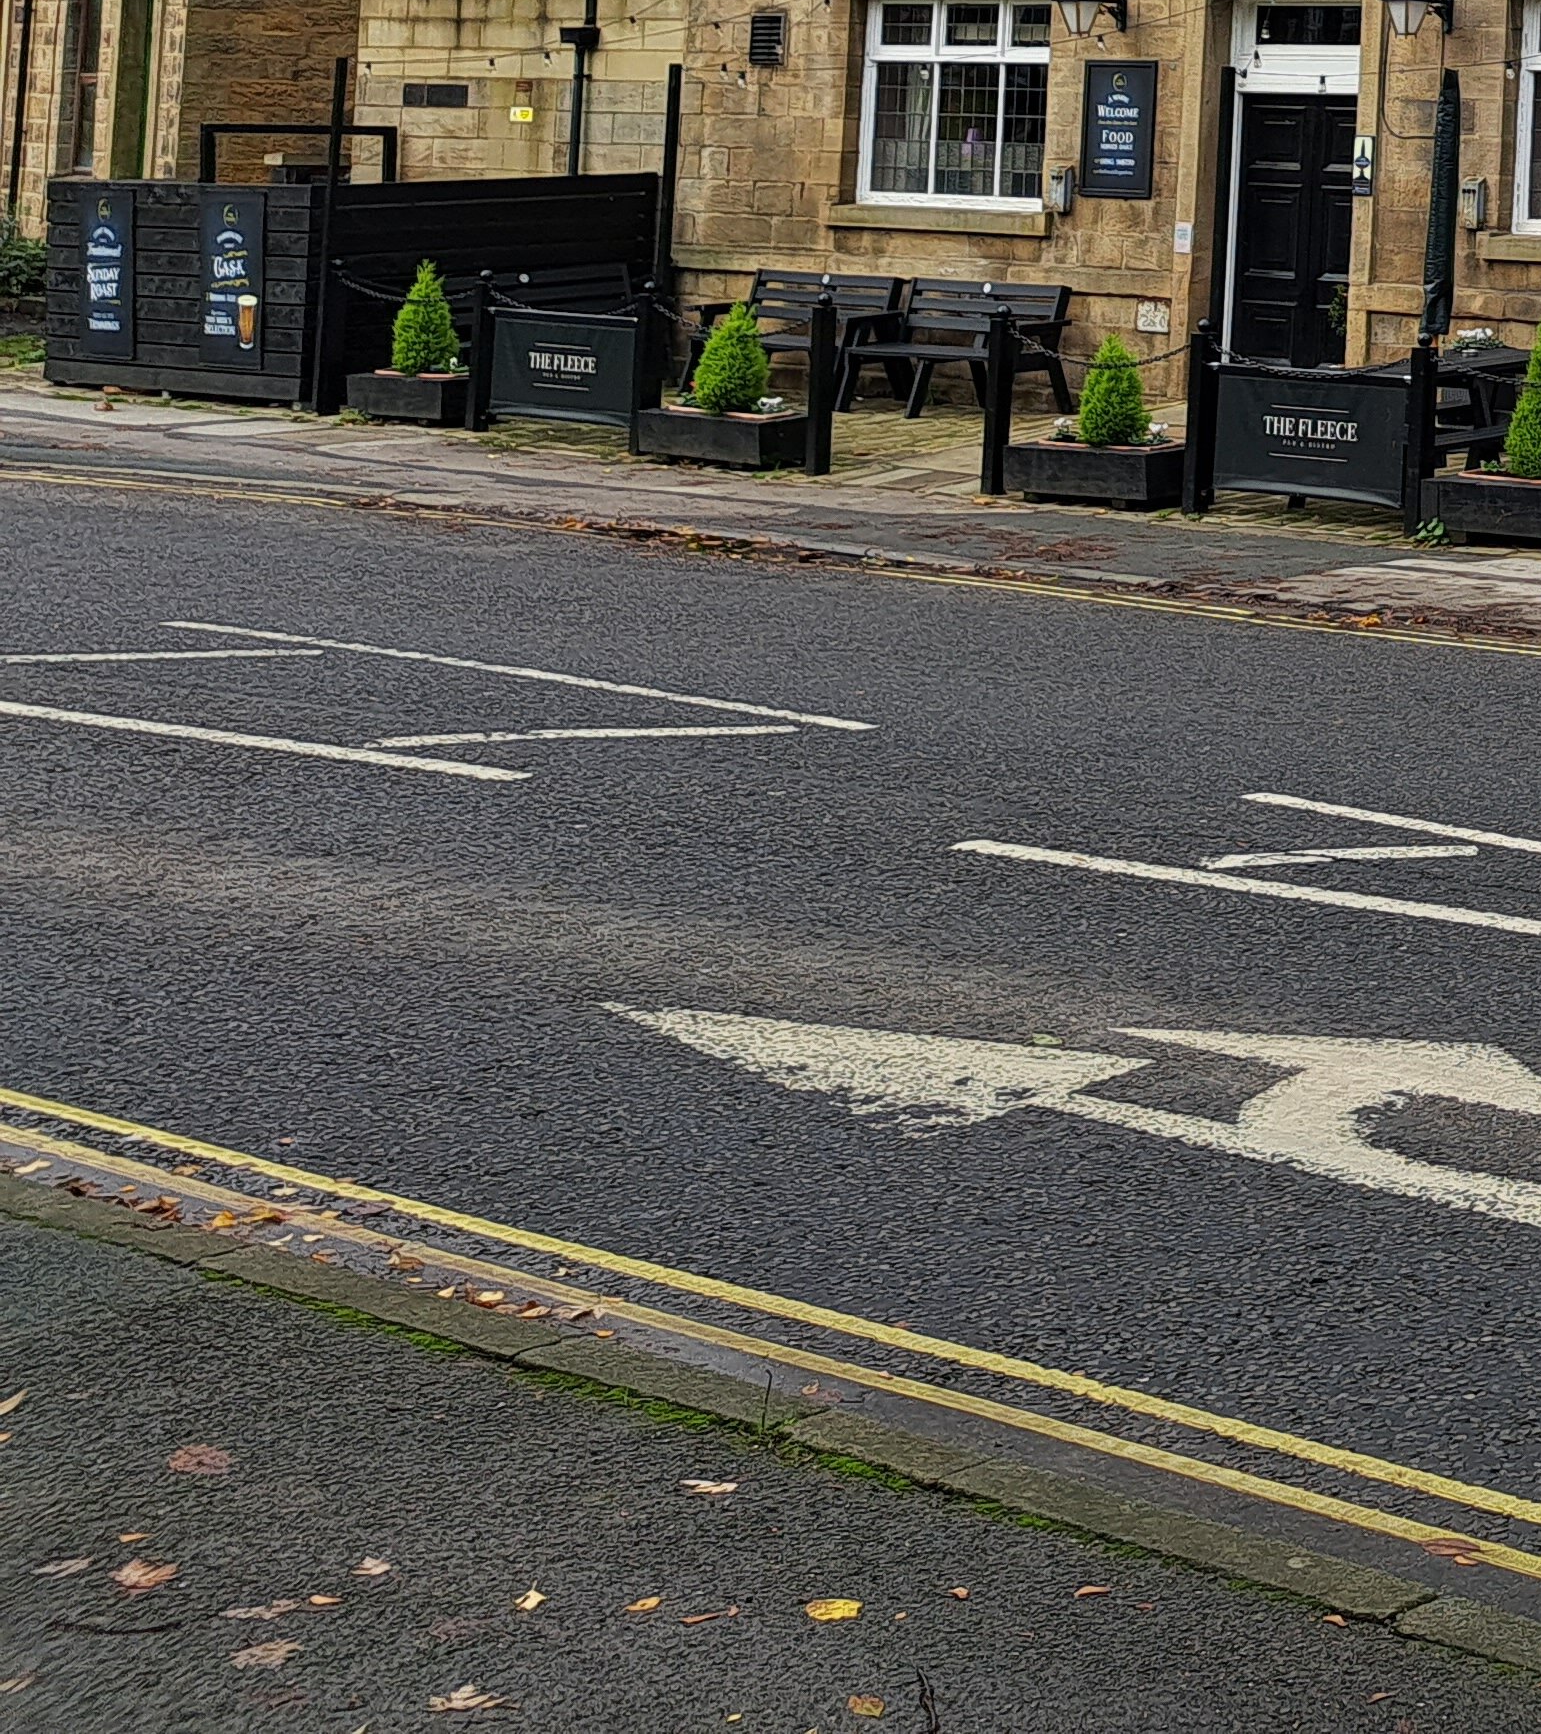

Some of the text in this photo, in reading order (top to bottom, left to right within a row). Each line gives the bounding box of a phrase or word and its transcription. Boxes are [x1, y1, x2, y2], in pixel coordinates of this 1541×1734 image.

[1102, 129, 1133, 143] FOOD
[528, 351, 598, 374] THE FLEECE
[1263, 415, 1359, 442] THE FLEECE
